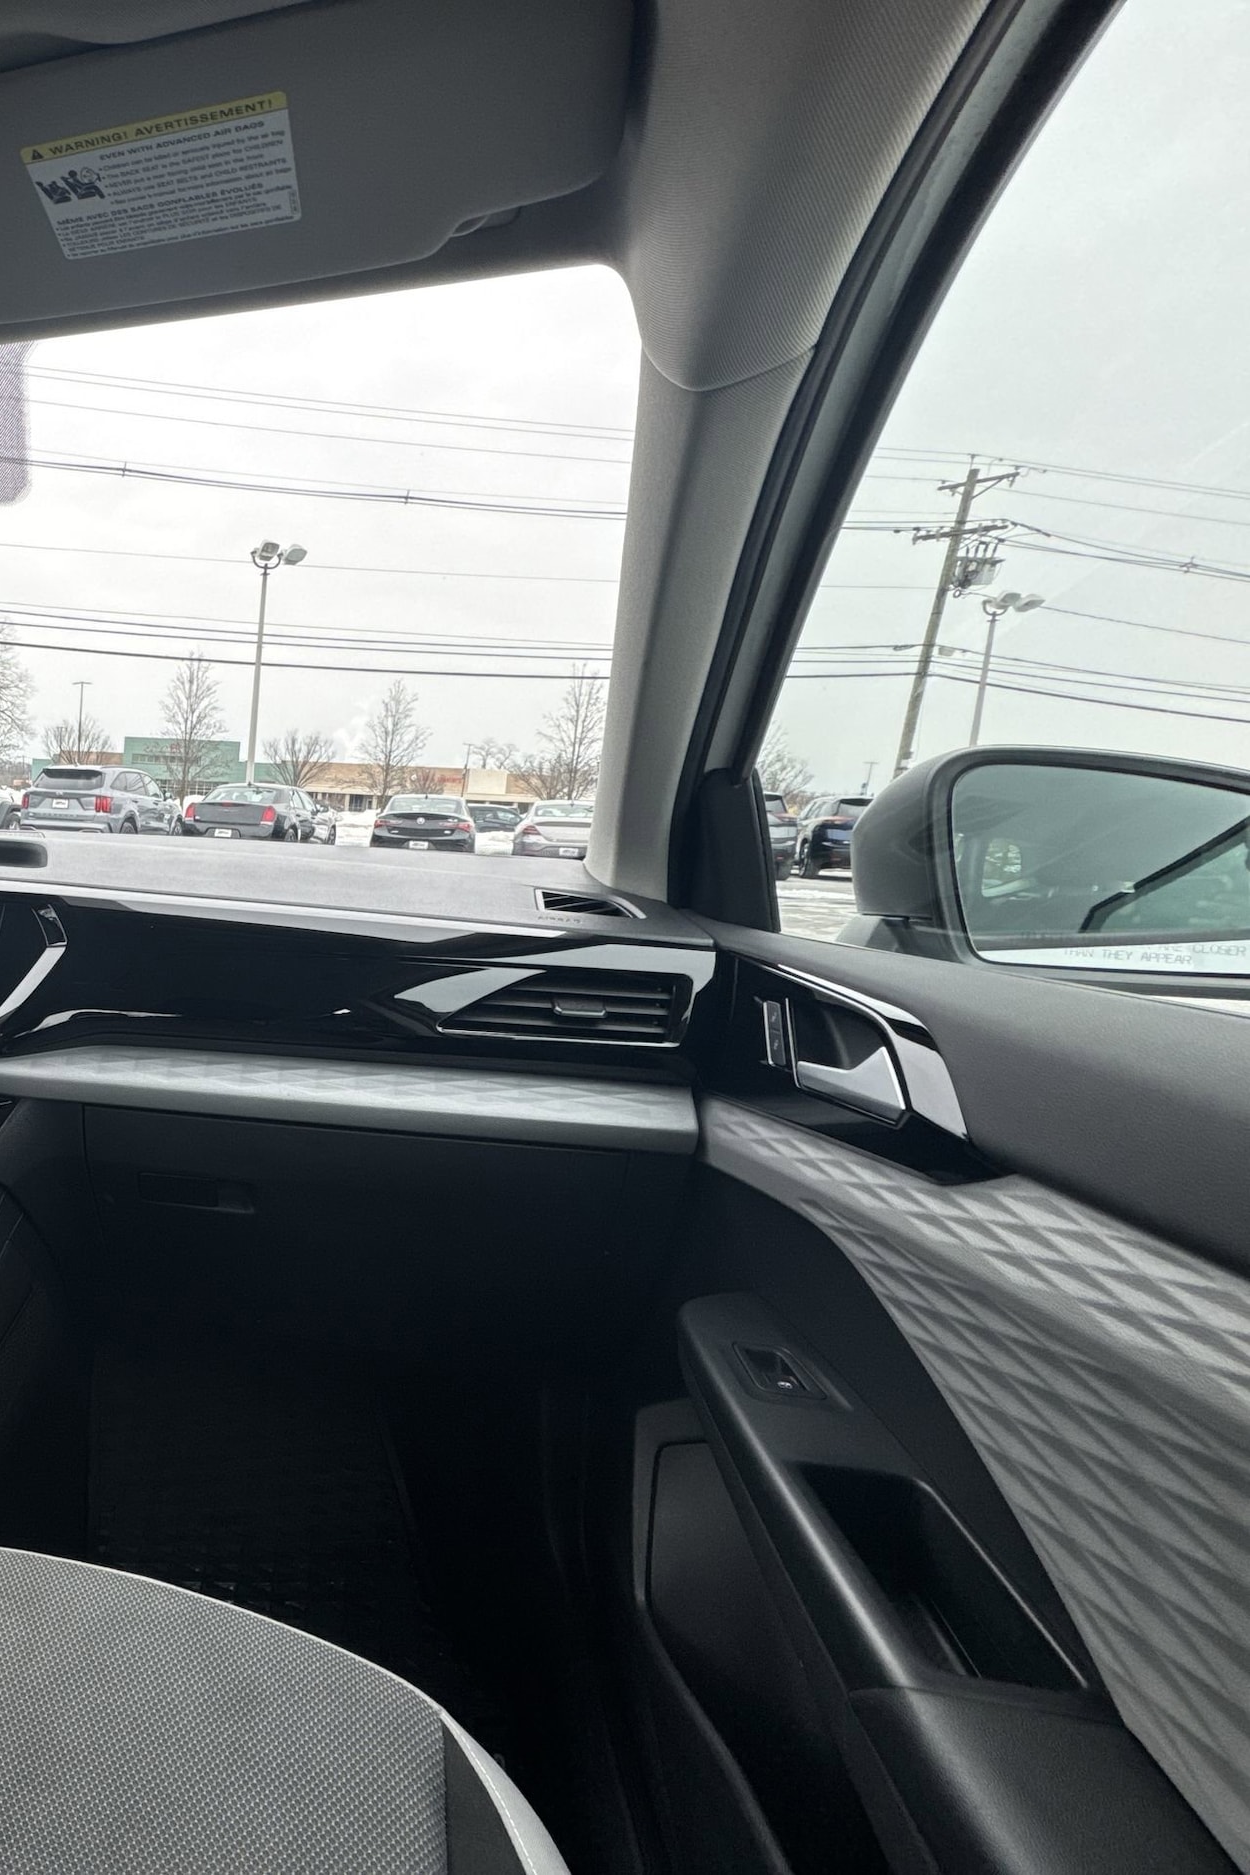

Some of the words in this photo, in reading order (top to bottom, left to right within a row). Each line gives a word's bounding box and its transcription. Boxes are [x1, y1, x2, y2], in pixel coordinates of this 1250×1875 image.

[49, 131, 129, 156] WARNING!
[134, 99, 273, 137] AVERTISSEMENT!
[99, 151, 125, 161] EVEN
[127, 145, 153, 155] WITH
[156, 132, 211, 149] ADVANCED
[213, 128, 232, 137] AIR
[235, 120, 264, 132] BAGS
[1103, 949, 1133, 960] THEY
[1140, 952, 1193, 964] APPEAR
[1192, 944, 1247, 957] CLOSER
